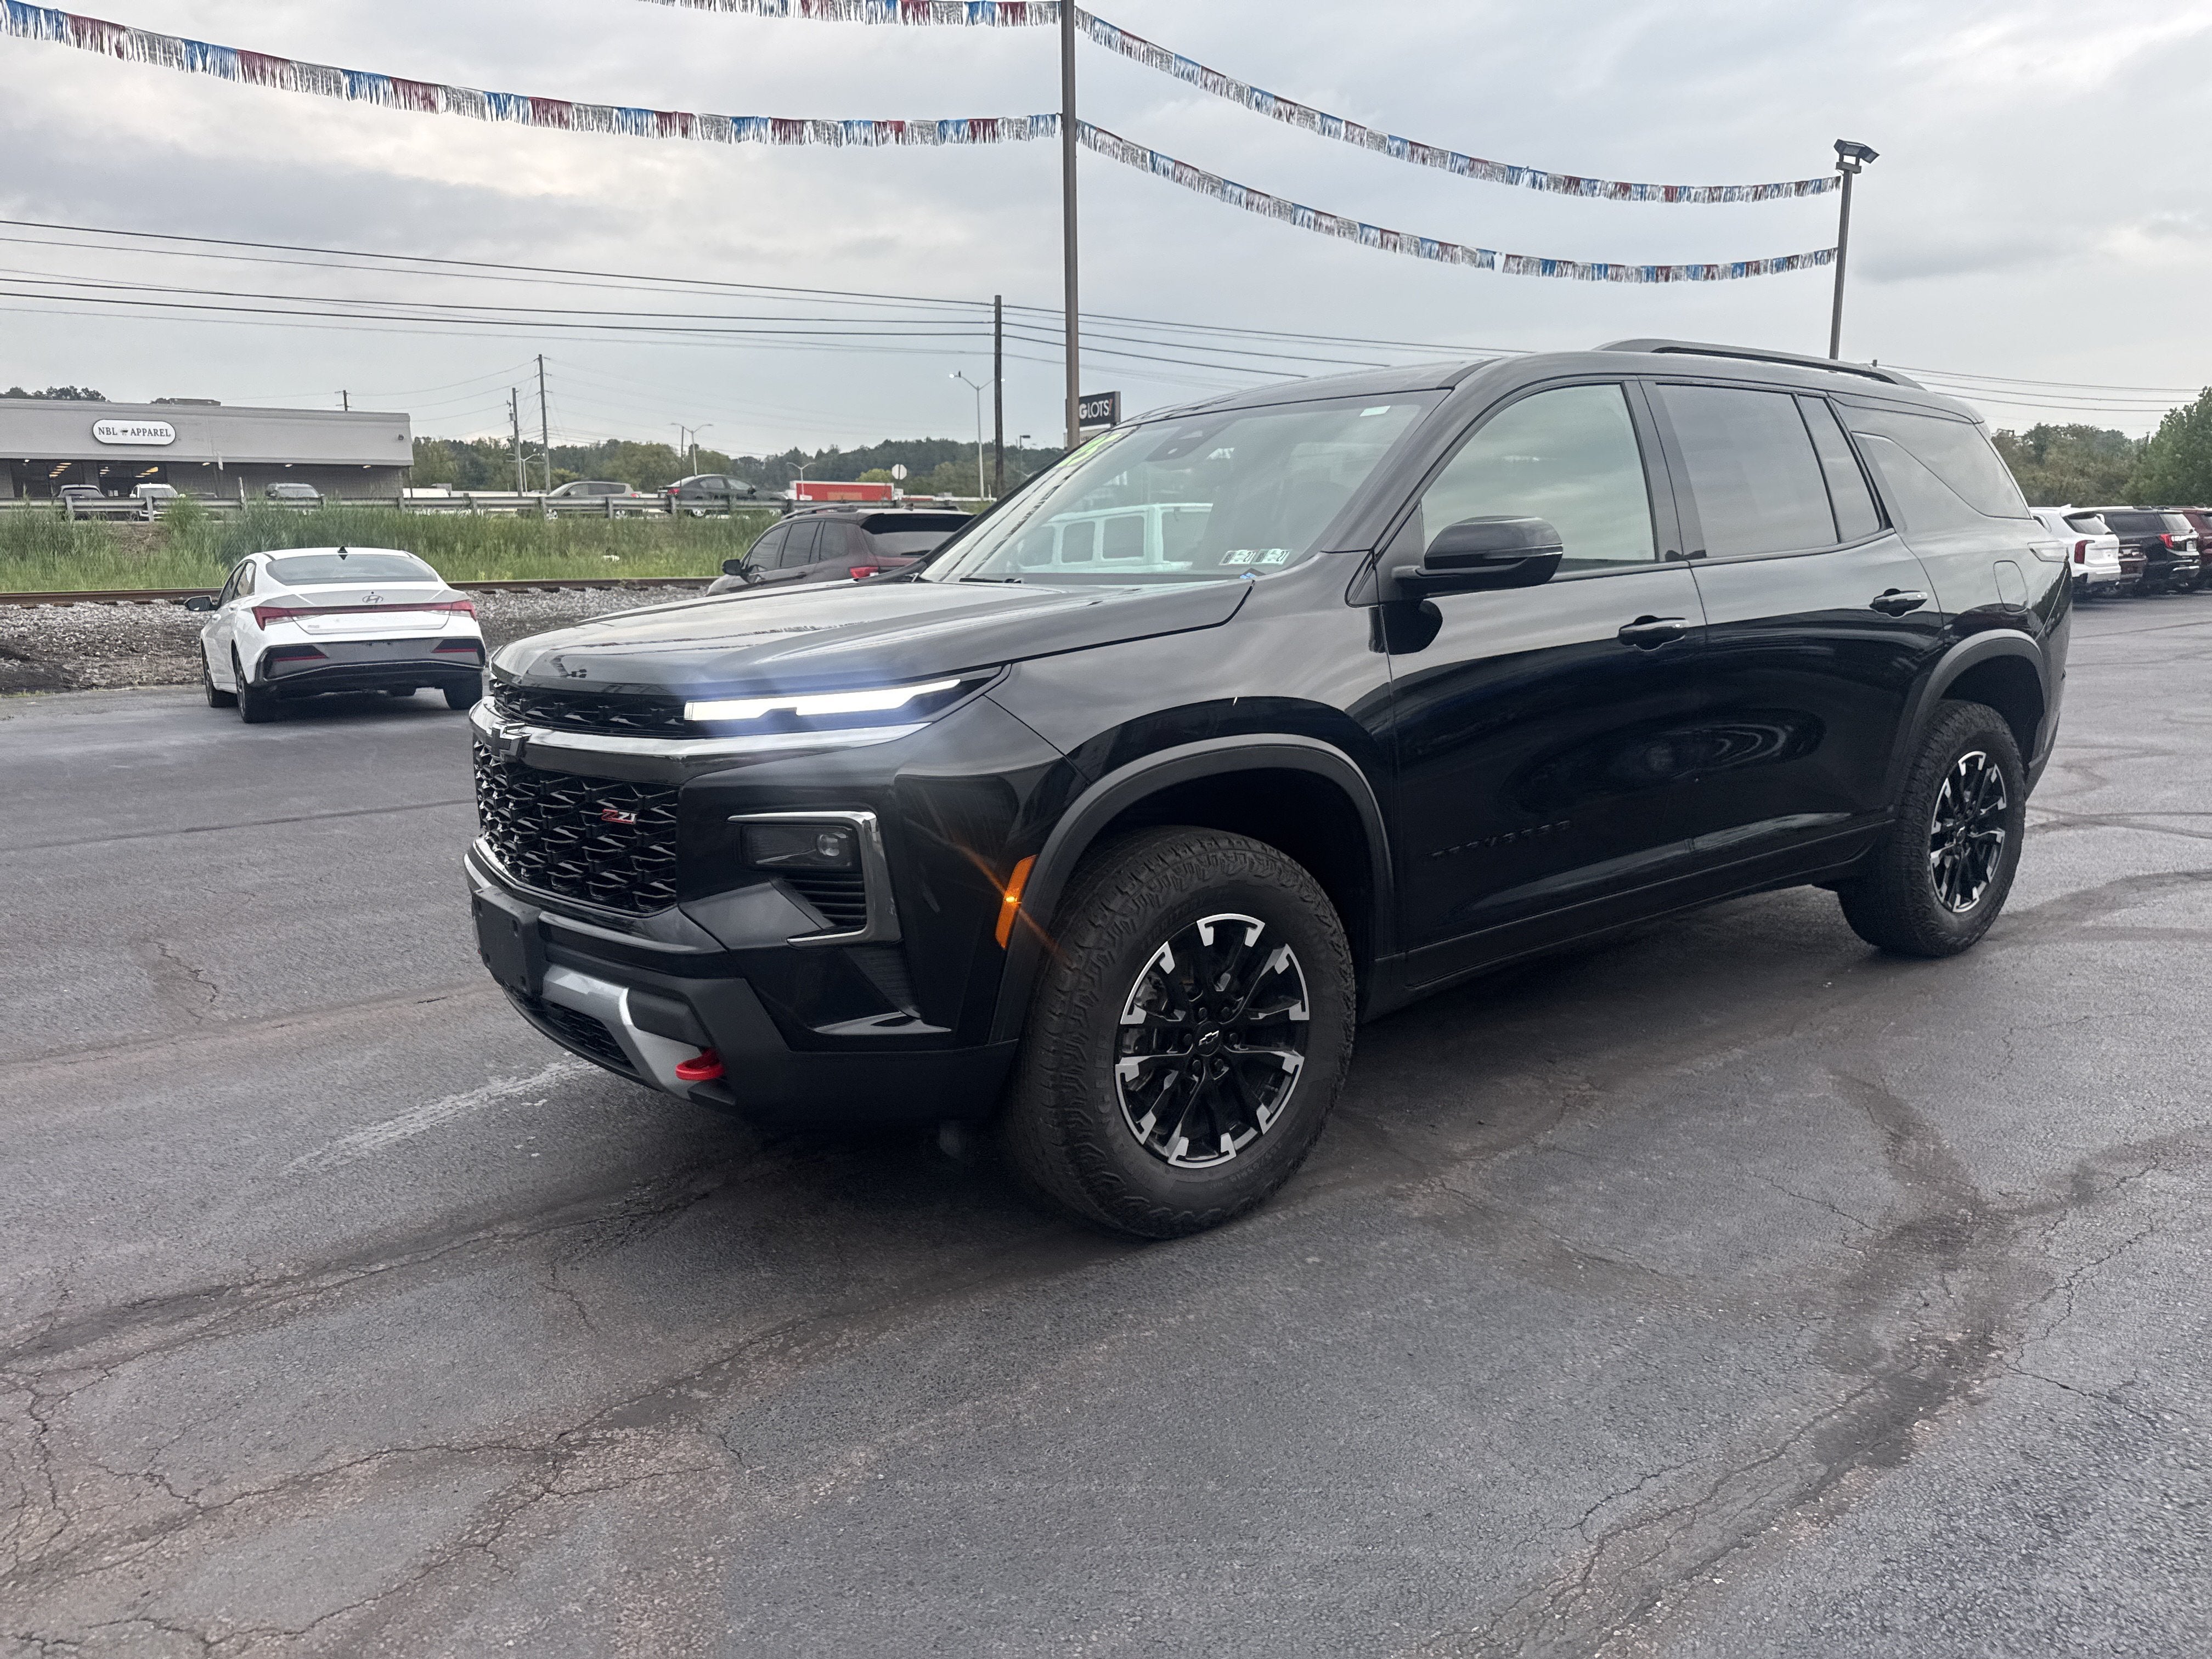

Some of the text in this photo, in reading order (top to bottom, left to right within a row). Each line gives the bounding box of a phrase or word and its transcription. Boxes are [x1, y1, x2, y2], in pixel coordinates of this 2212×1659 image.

[98, 427, 171, 437] NBL APPAREL
[1276, 551, 1289, 562] 27
[601, 808, 637, 825] Z71
